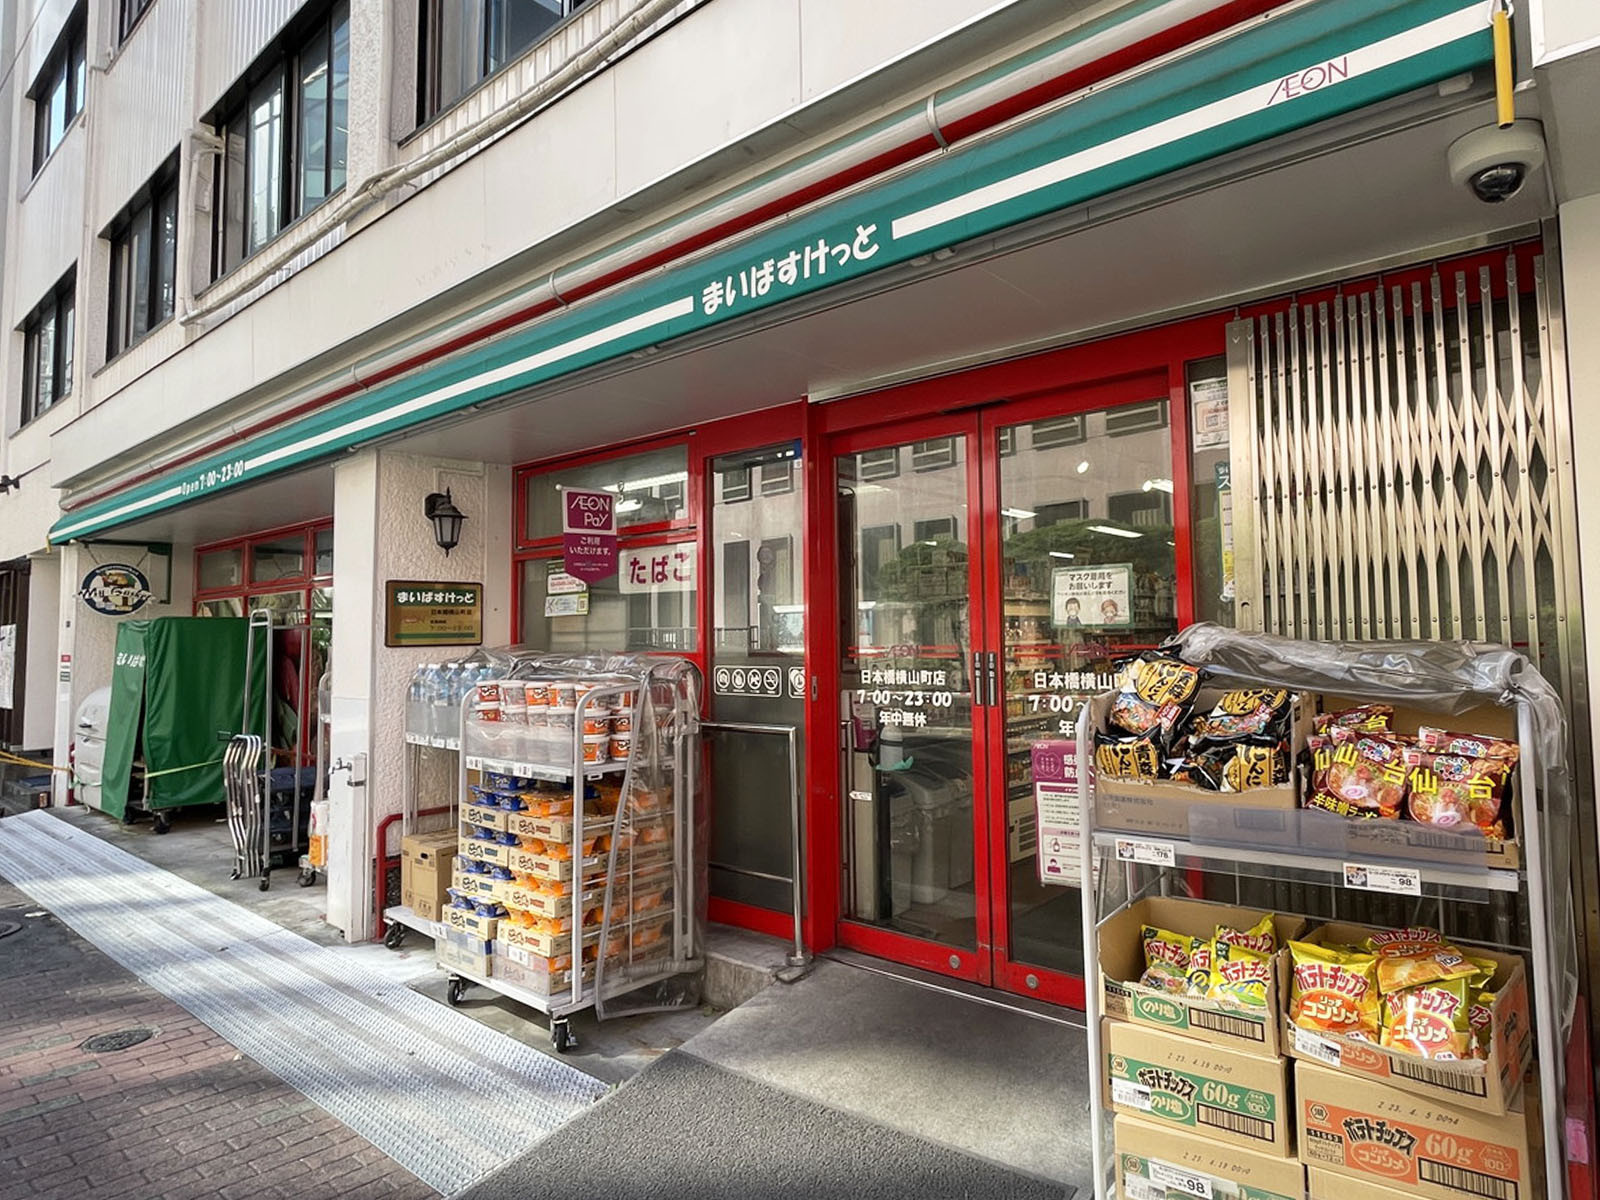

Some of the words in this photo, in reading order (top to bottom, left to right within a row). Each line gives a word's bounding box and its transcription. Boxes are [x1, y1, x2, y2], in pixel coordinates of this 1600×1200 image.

[702, 224, 879, 315] まいばすけっと
[630, 552, 690, 584] たばこ
[397, 591, 475, 603] まいばすけっと
[861, 669, 946, 686] 日本橋横山町店
[879, 710, 927, 728] 年中無休
[1294, 964, 1370, 1003] ポテトチップス
[1143, 1001, 1176, 1019] のり塩
[1303, 1000, 1360, 1025] コンソメ
[1393, 1022, 1449, 1043] コンソメ
[1140, 1068, 1198, 1102] ポテトチップス
[1202, 1081, 1241, 1109] 60g
[1151, 1095, 1184, 1116] のり塩
[1343, 1117, 1416, 1156] ポテトチップス
[1358, 1149, 1404, 1170] コンソメ
[1425, 1133, 1474, 1166] 60g
[1186, 1179, 1206, 1194] 98
